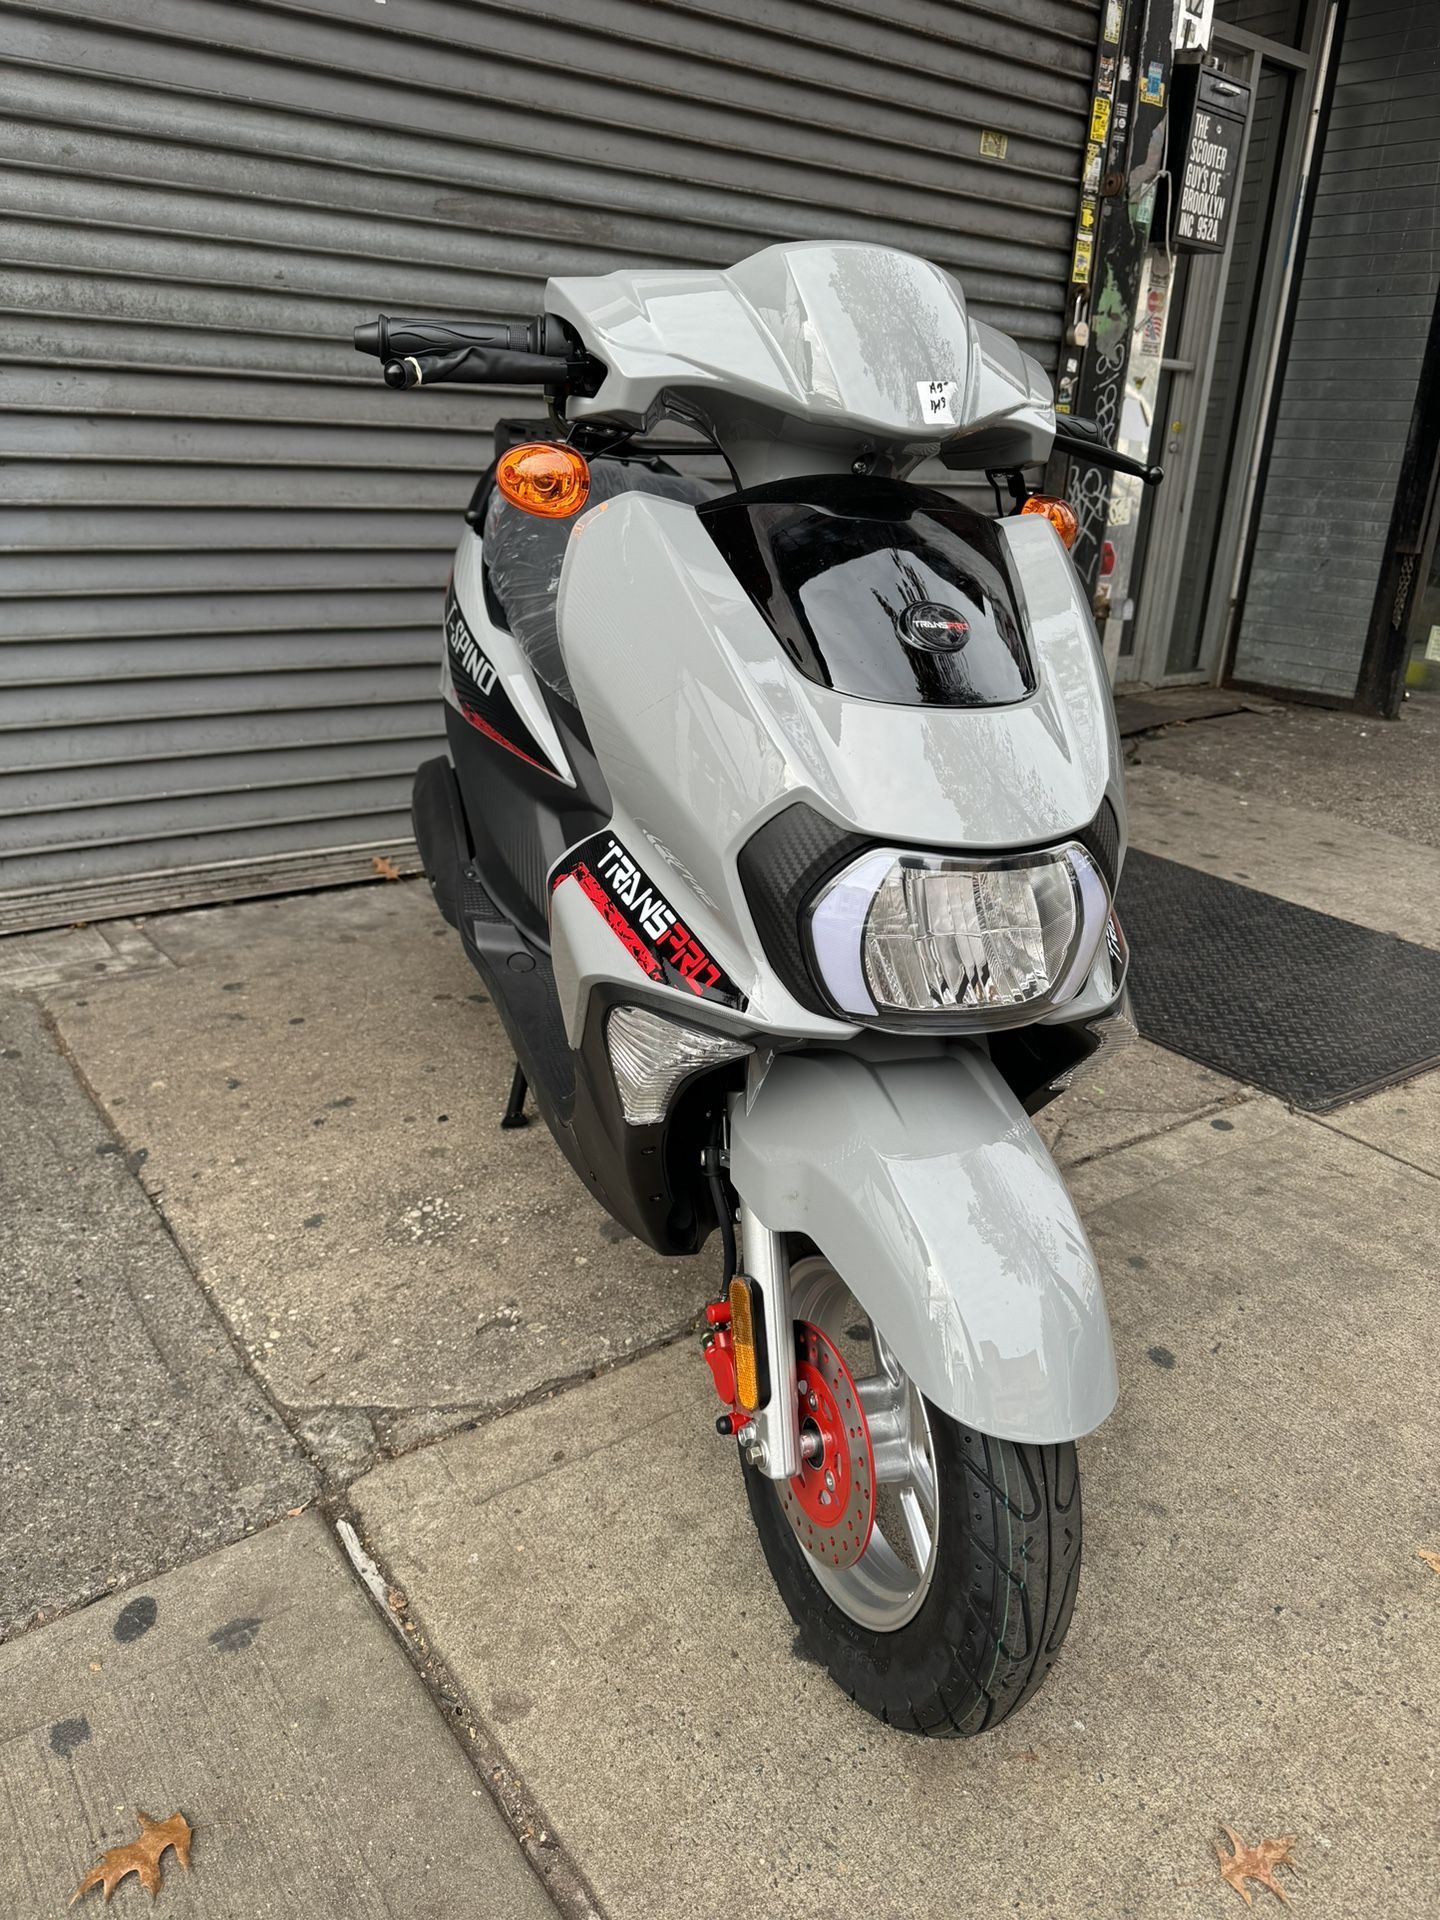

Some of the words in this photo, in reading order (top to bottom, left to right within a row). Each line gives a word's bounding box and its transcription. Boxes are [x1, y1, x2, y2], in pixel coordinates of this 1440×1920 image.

[1194, 113, 1211, 139] THE
[1190, 138, 1228, 170] SCOOTER
[1185, 163, 1209, 192] GUY'S
[1209, 172, 1221, 195] OF
[1181, 187, 1226, 220] BROOKLYN
[1178, 212, 1194, 238] INC
[1196, 216, 1219, 242] 952A
[913, 620, 969, 632] TRANSPRO
[597, 839, 722, 996] TRANSPRO
